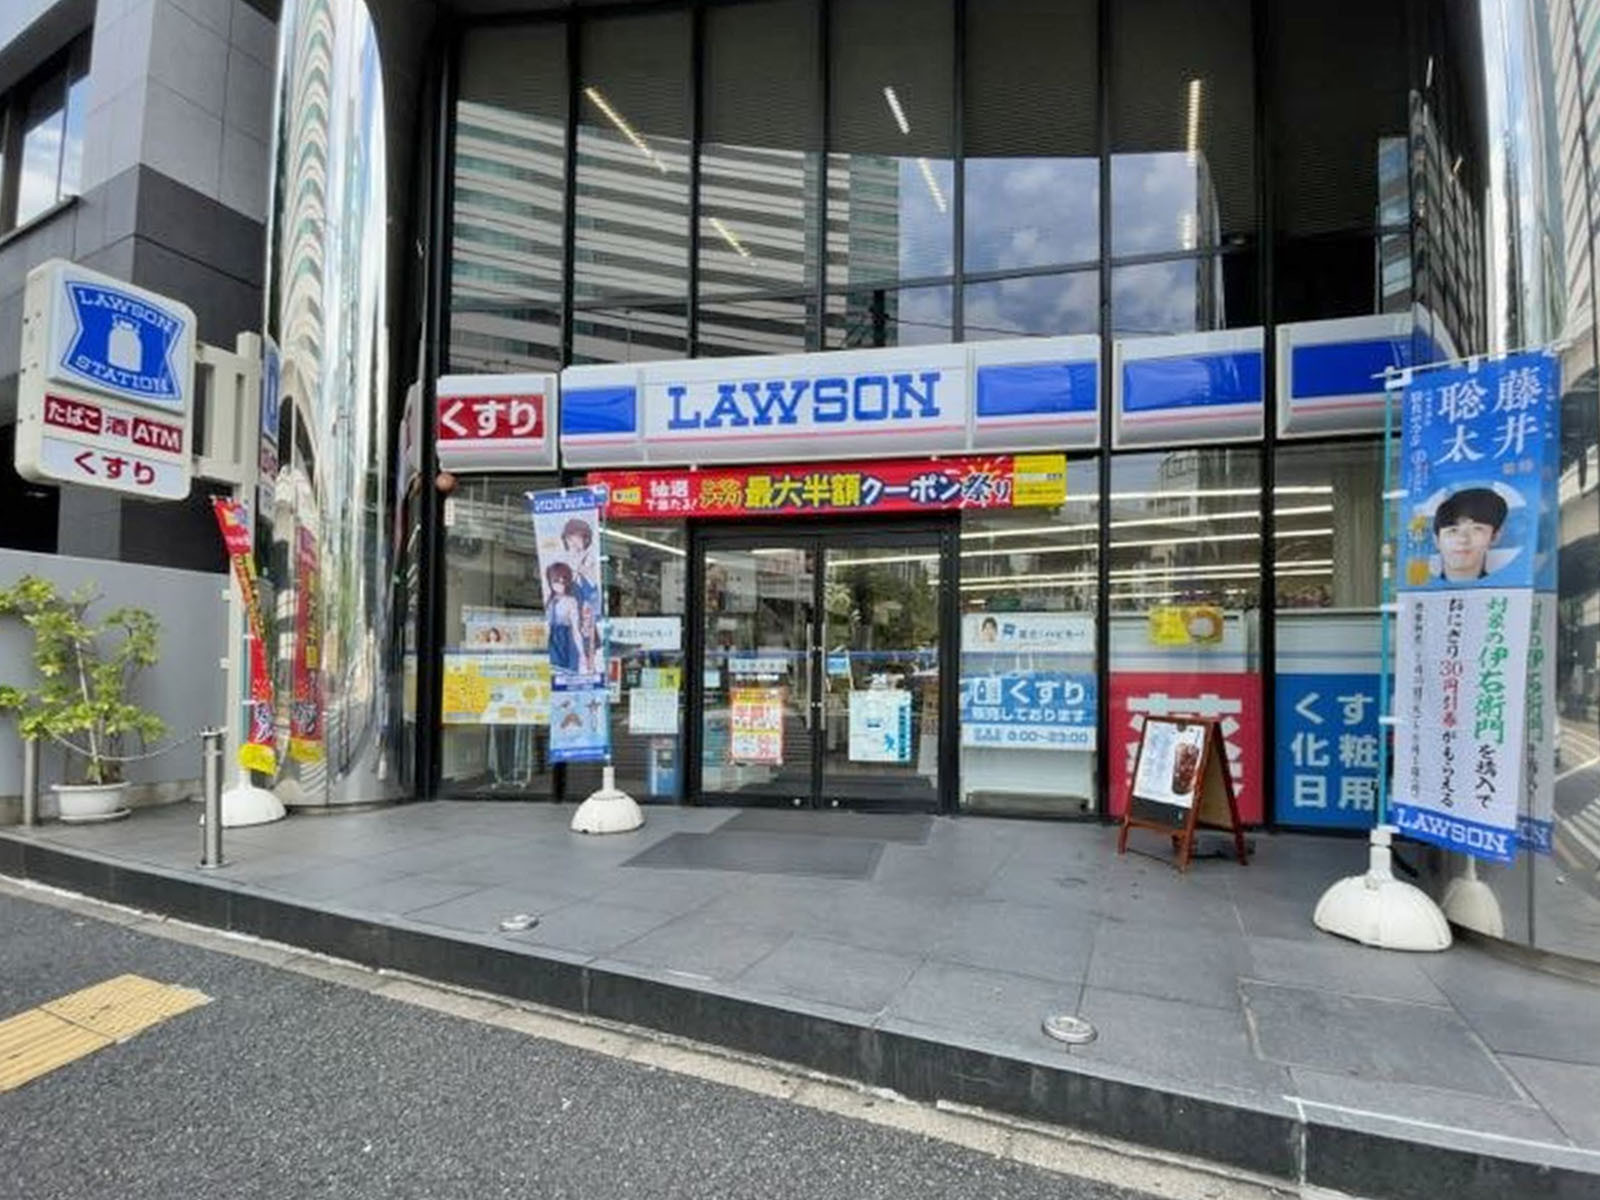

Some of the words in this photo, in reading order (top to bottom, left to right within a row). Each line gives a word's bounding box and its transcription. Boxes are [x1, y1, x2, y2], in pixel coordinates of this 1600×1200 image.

[78, 290, 174, 333] LAWSON
[75, 355, 169, 393] STATION
[442, 399, 537, 436] くすり
[668, 372, 940, 430] LAWSON
[1433, 379, 1488, 466] 聡太
[1491, 366, 1543, 460] 藤井
[48, 401, 100, 431] たばこ
[134, 423, 180, 451] ATM
[74, 451, 156, 484] くすり
[1009, 680, 1084, 705] くすり
[1397, 807, 1509, 855] LAWSON
